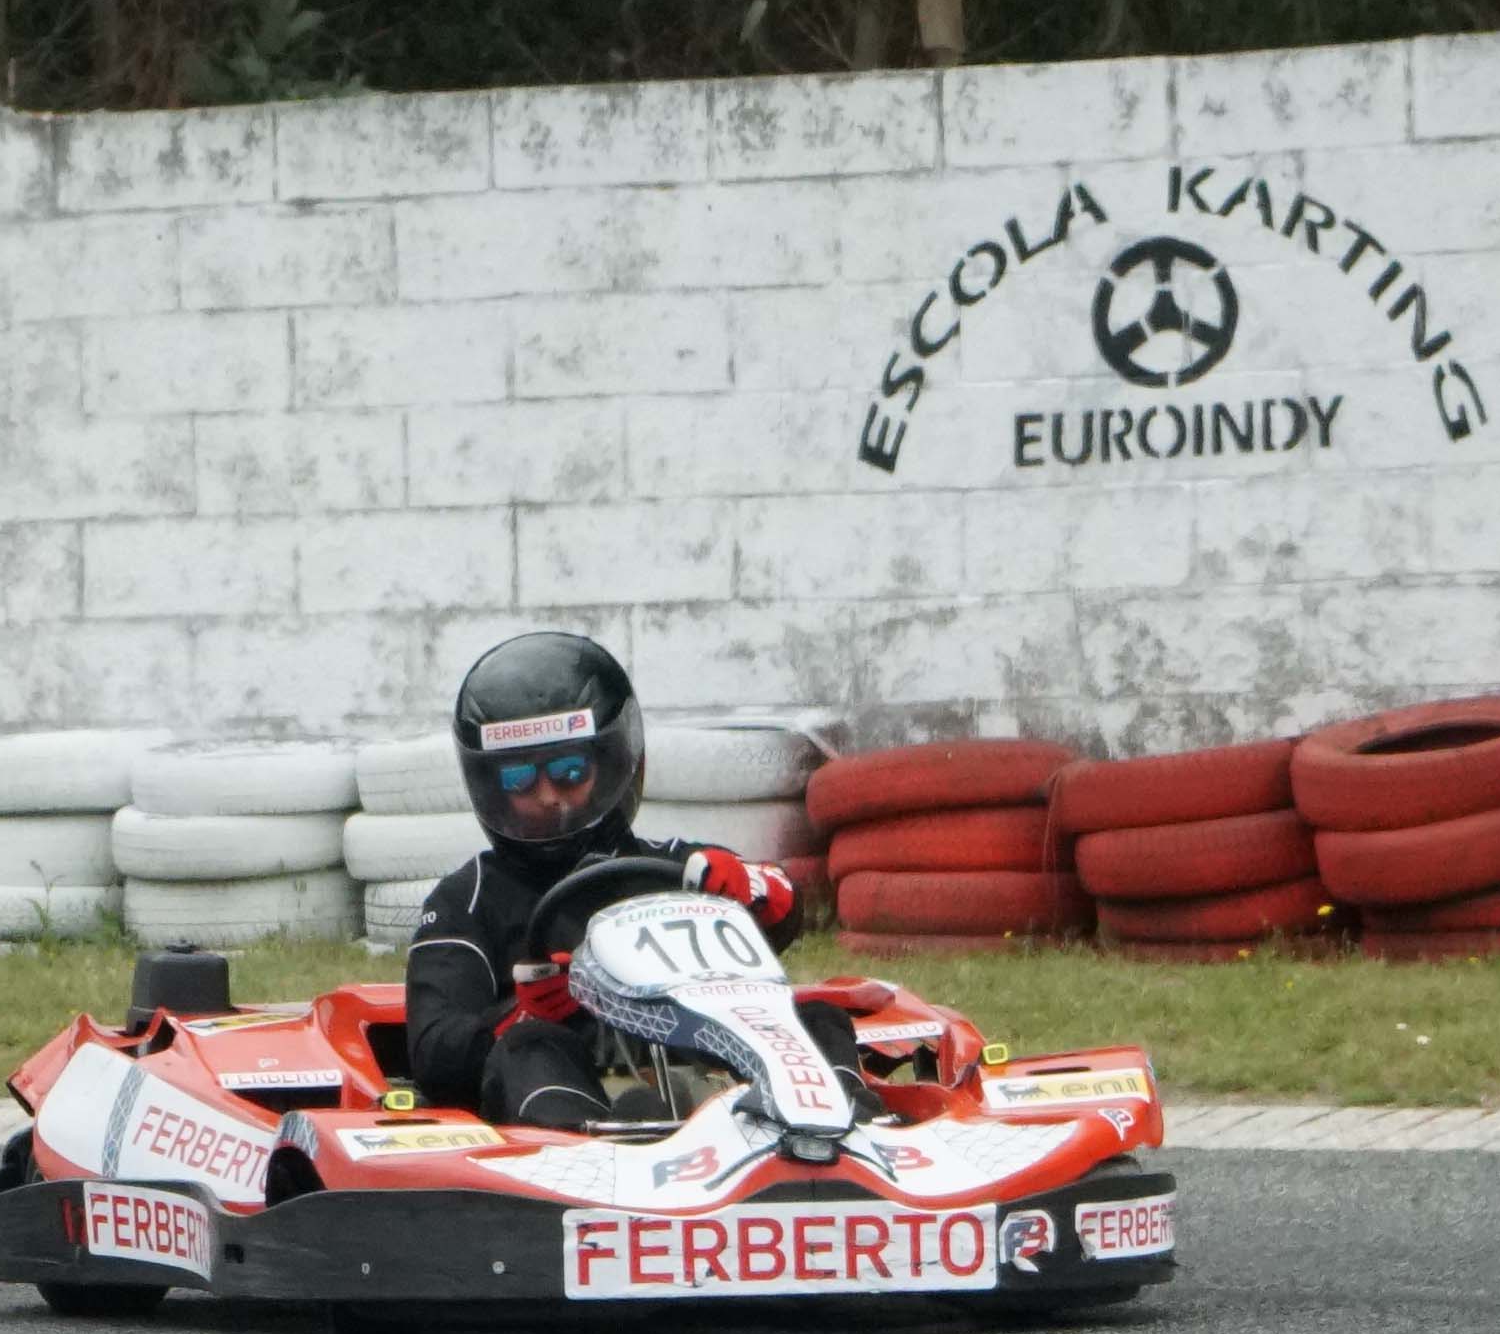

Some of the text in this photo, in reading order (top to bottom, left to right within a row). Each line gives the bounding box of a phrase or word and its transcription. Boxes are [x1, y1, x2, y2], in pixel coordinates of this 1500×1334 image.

[857, 166, 1488, 473] ESCOLA KARTING
[1013, 394, 1344, 468] EUROINDY
[486, 718, 564, 742] FERBERTO
[615, 904, 729, 928] EUROINDY
[634, 918, 763, 973] 170
[576, 1211, 985, 1287] FERBERTO
